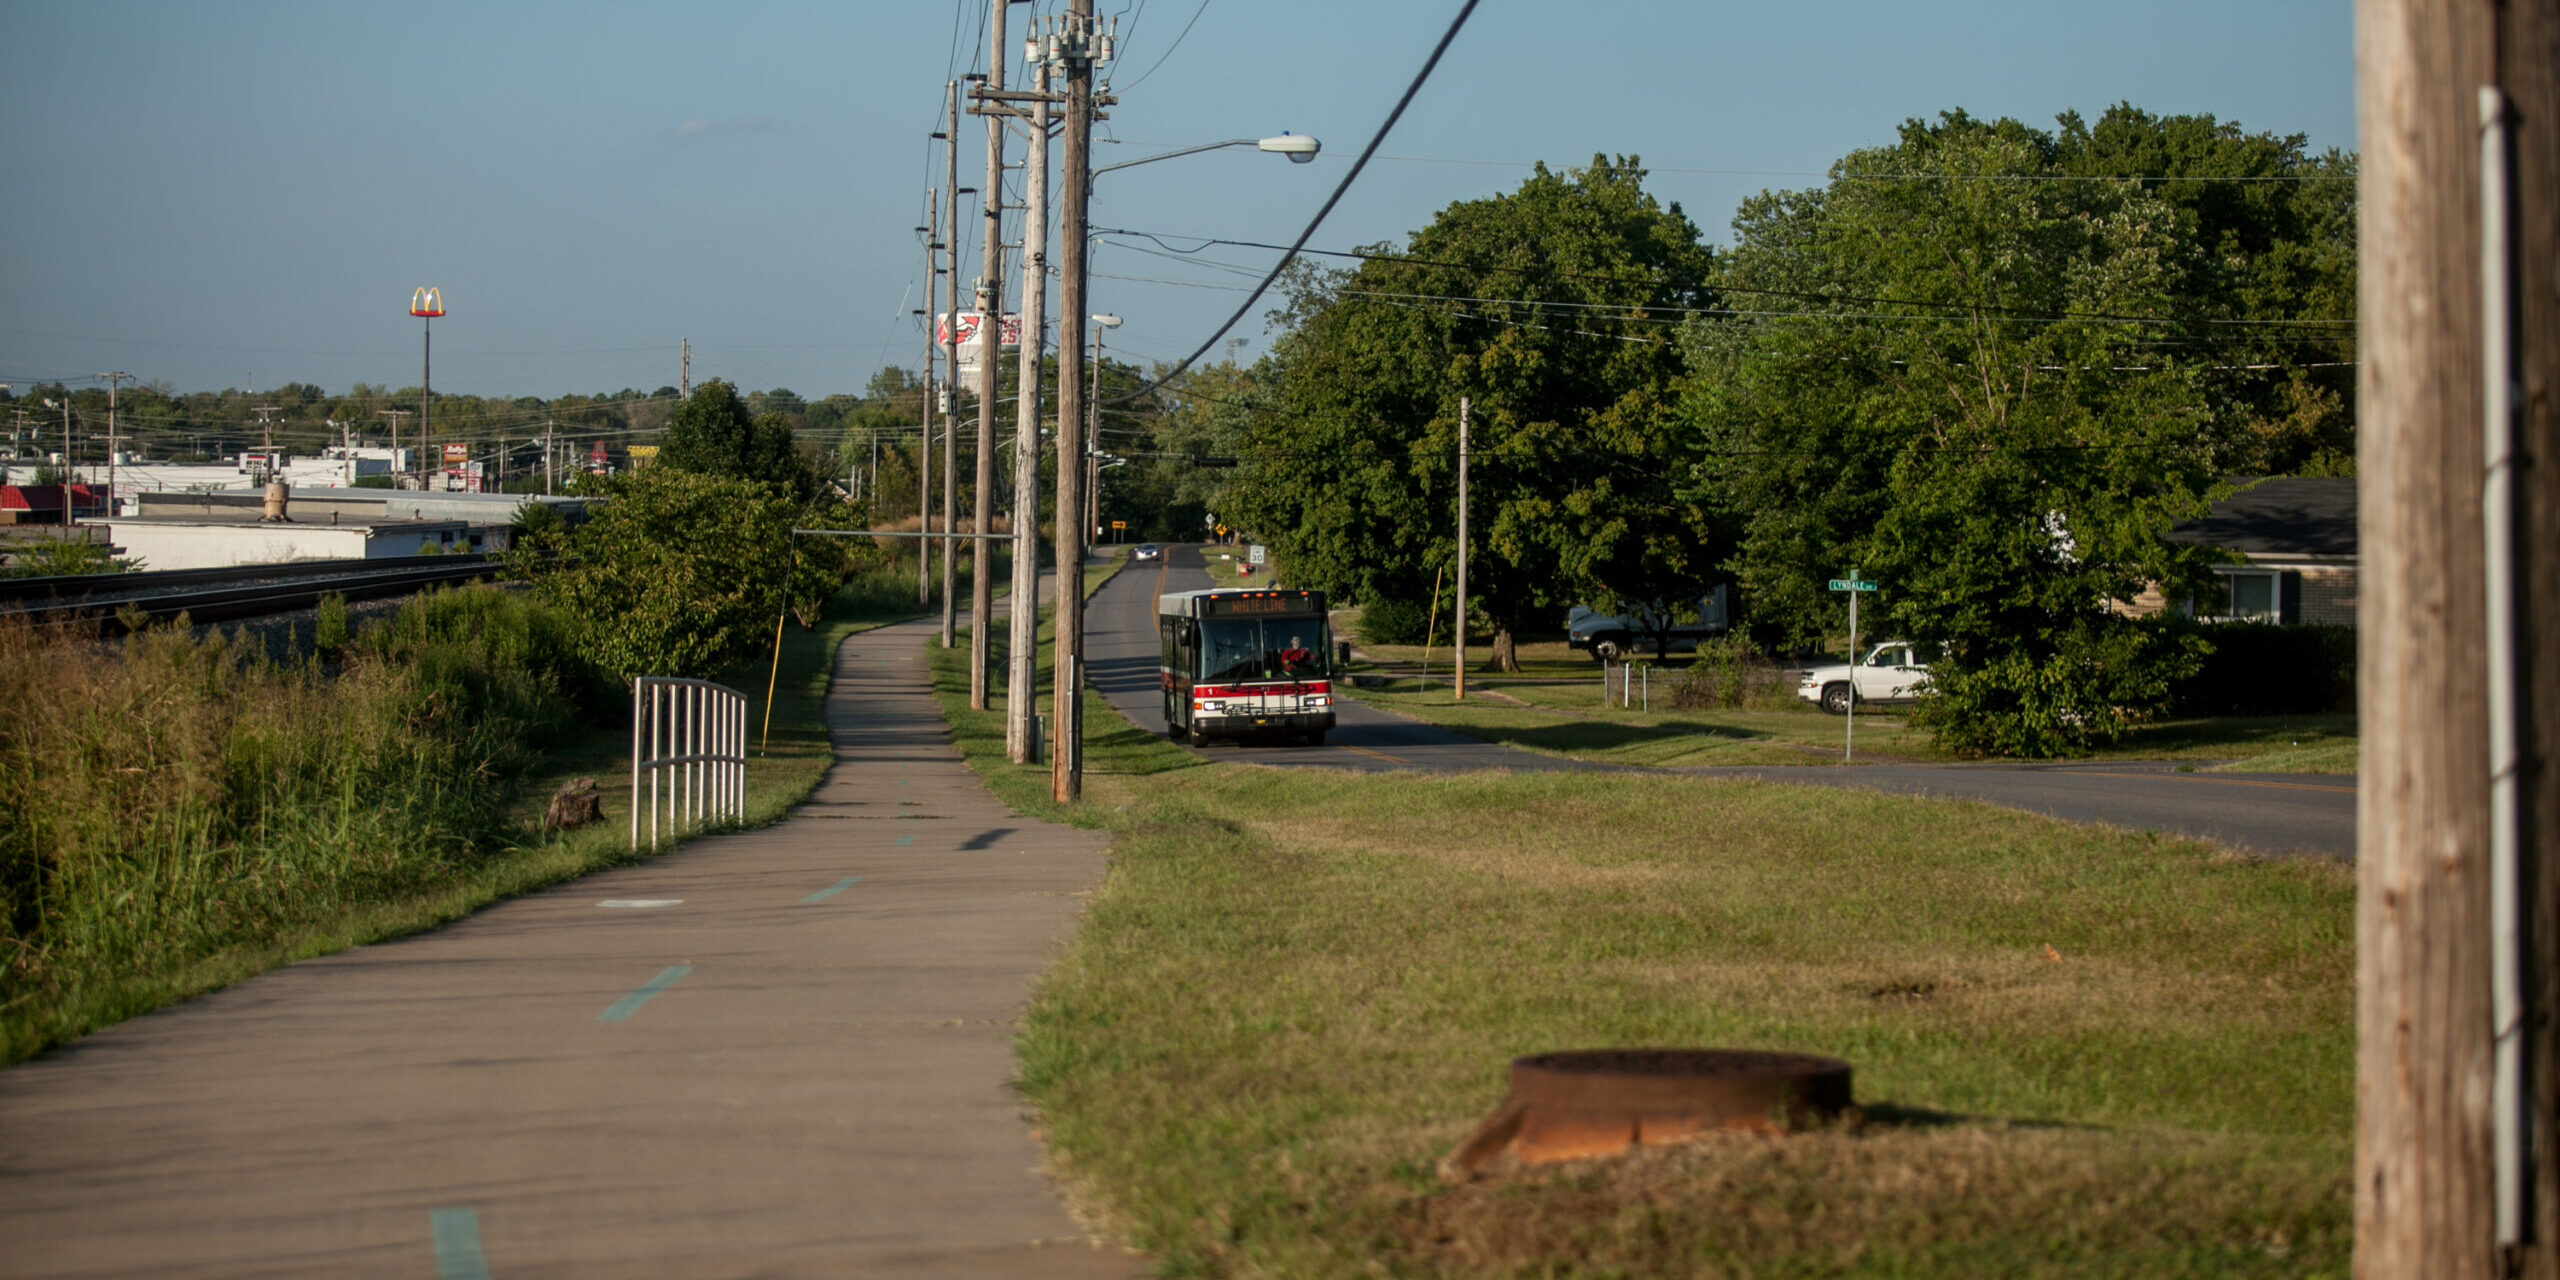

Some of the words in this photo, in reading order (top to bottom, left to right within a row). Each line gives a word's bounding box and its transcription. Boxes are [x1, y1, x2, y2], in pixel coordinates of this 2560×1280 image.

[1834, 581, 1864, 590] LYNDALE
[1232, 598, 1261, 613] WHITE
[1264, 597, 1286, 611] LINE
